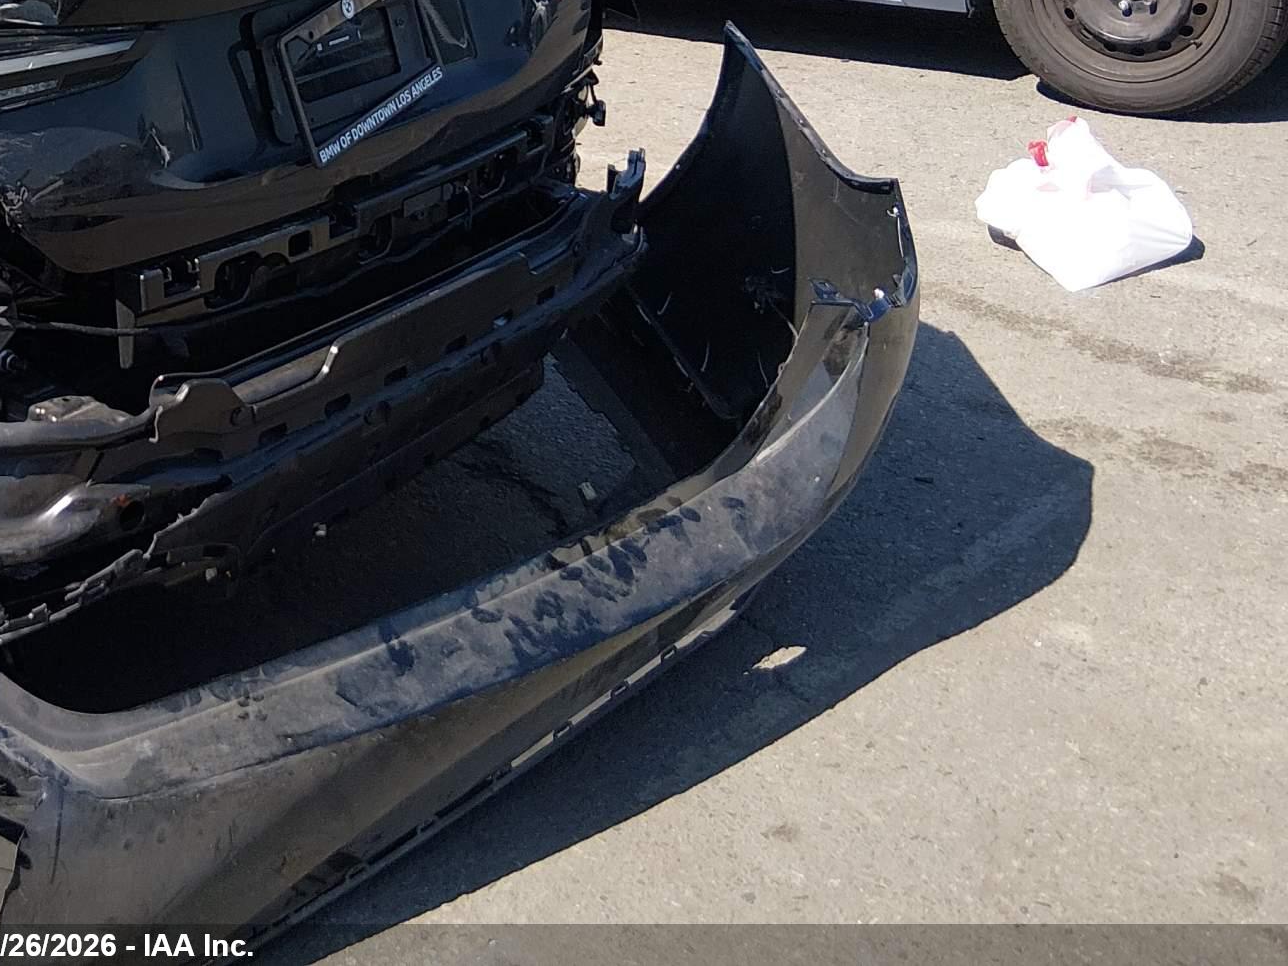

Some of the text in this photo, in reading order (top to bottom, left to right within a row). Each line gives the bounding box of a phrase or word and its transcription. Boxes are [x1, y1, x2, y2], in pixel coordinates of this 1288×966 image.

[319, 66, 443, 164] BMW OF DOWNTOWN LOS ANGELES
